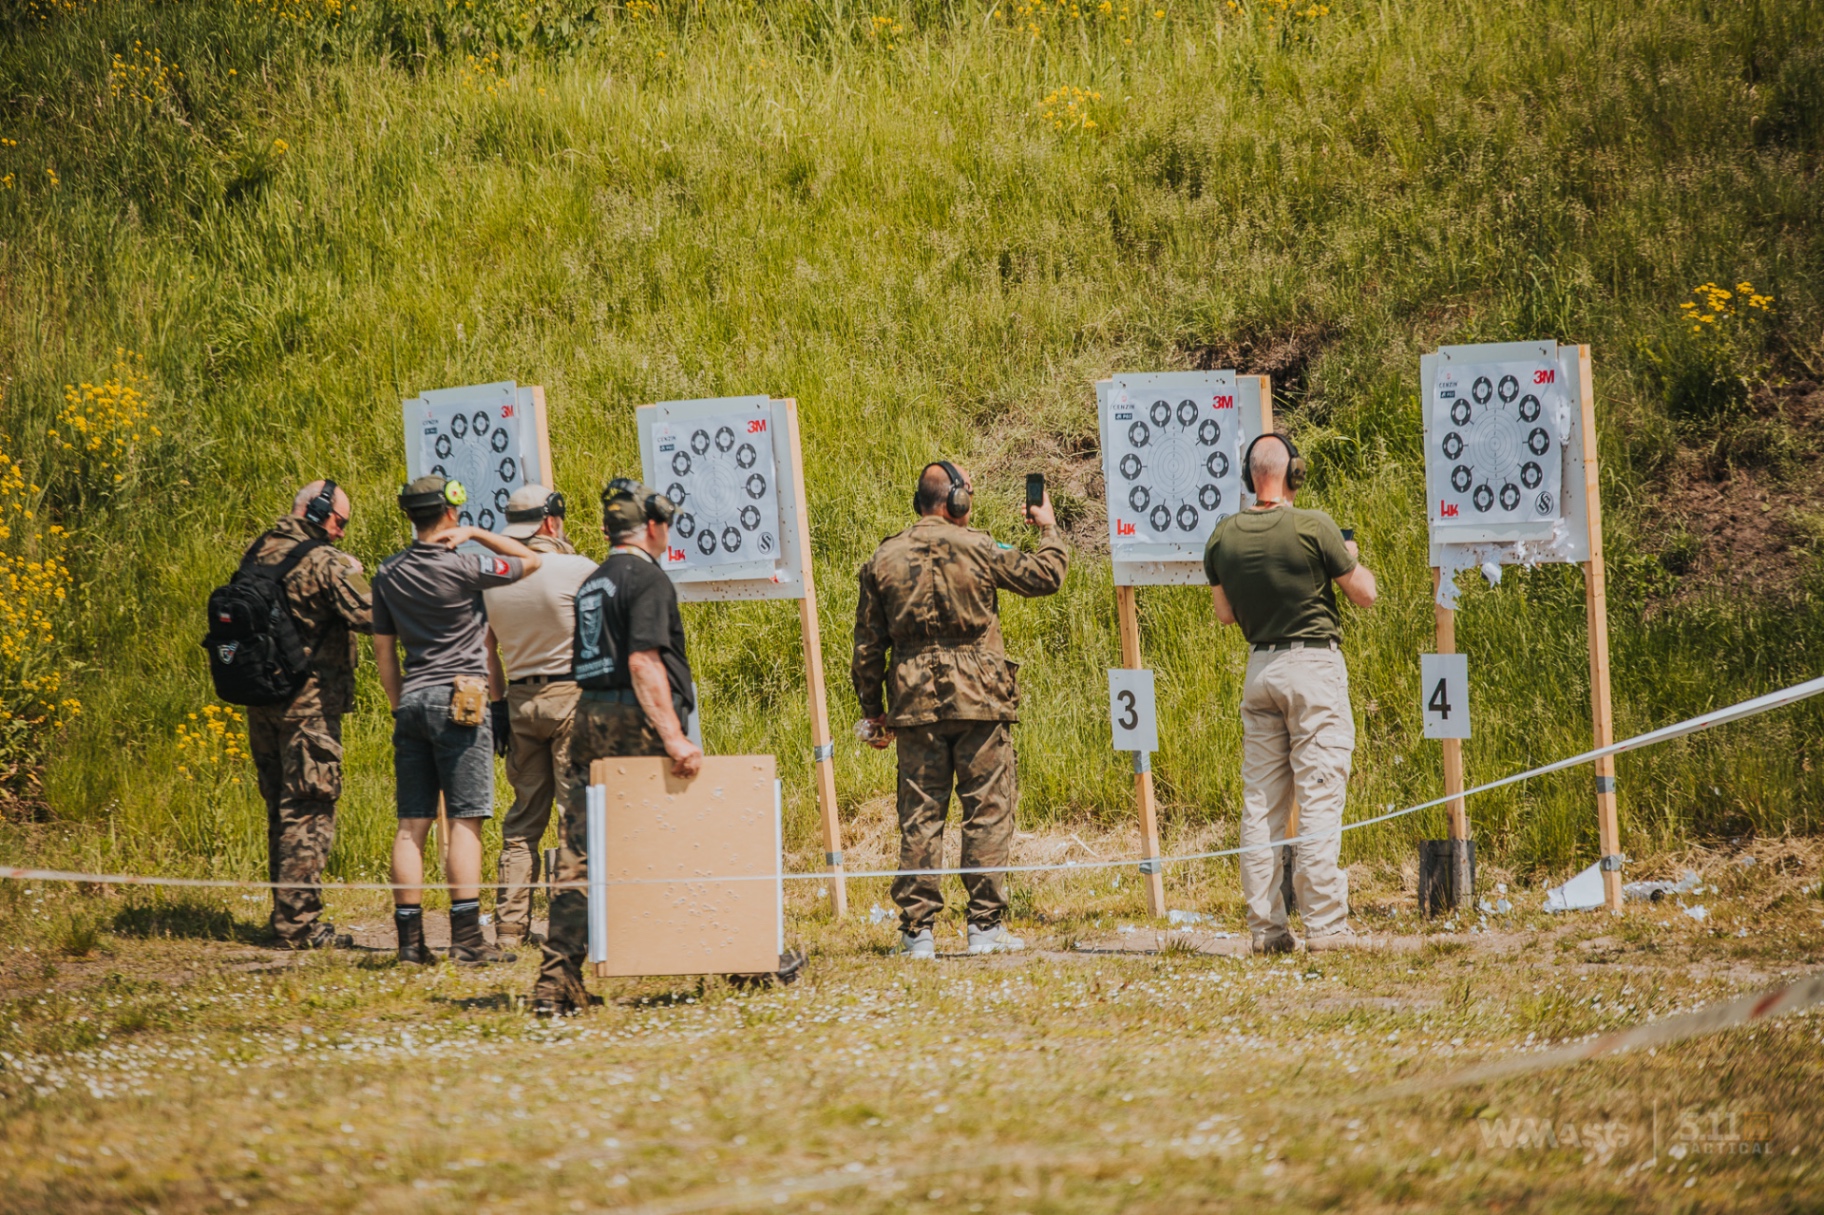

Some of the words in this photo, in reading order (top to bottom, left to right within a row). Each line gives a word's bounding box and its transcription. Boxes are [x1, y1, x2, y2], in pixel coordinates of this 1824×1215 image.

[1533, 369, 1555, 384] 3M
[1212, 395, 1233, 409] 3M
[501, 405, 514, 418] 3M
[747, 419, 766, 433] 3M
[1428, 677, 1451, 720] 4
[1117, 689, 1139, 730] 3
